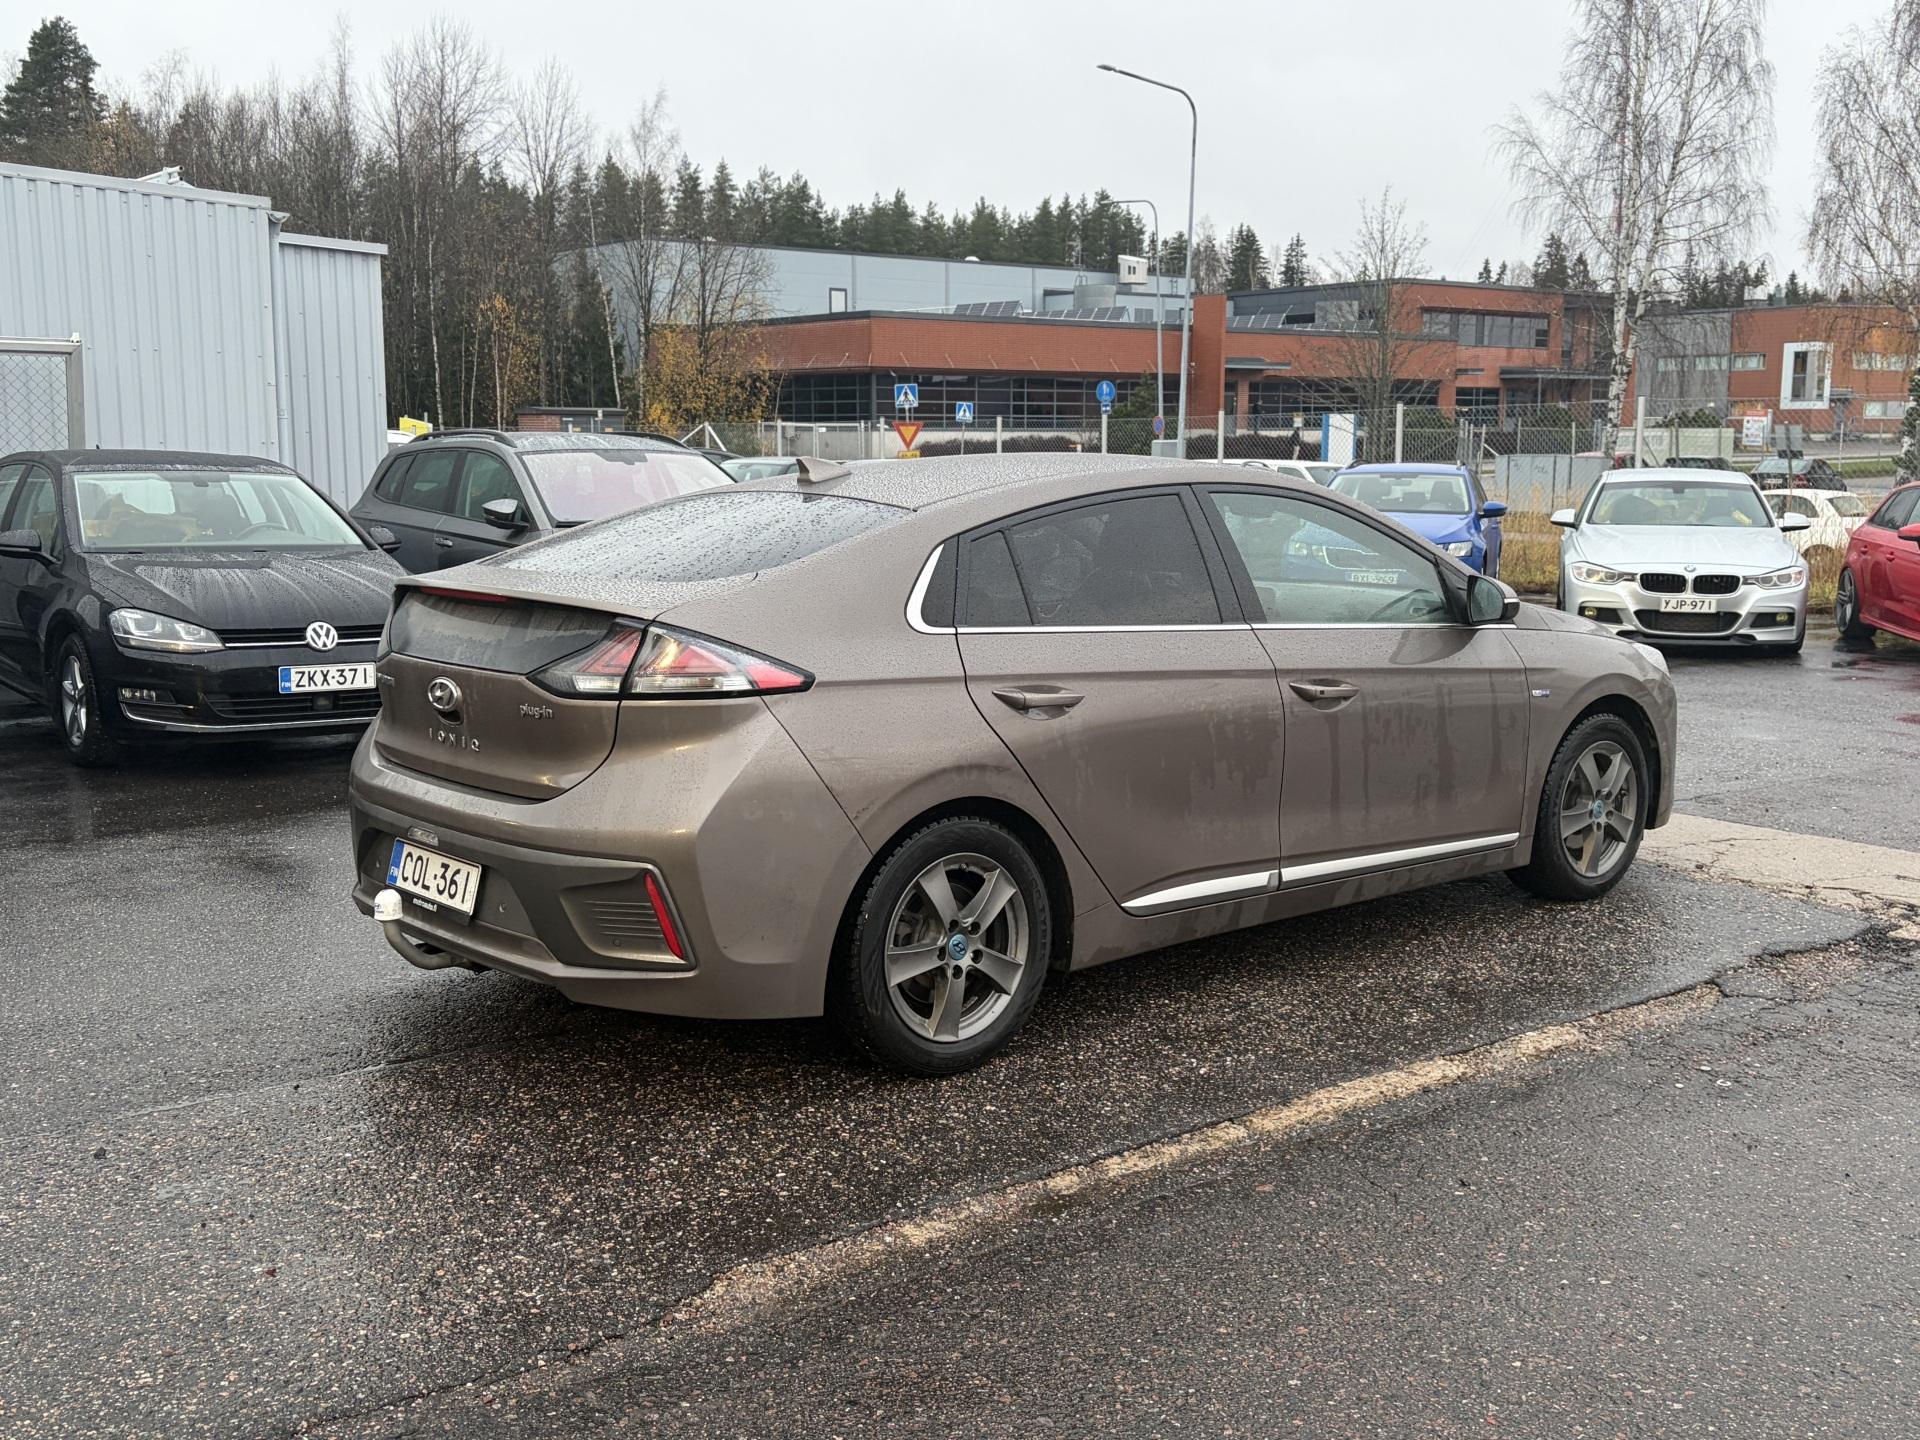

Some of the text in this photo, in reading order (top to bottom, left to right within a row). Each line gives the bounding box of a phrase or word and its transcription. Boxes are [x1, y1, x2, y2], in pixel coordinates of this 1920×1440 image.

[1664, 599, 1711, 610] YJP-971
[294, 667, 368, 688] ZKX-371
[519, 703, 553, 719] plug-in
[428, 728, 480, 751] IONIQ
[401, 851, 470, 905] COL-361
